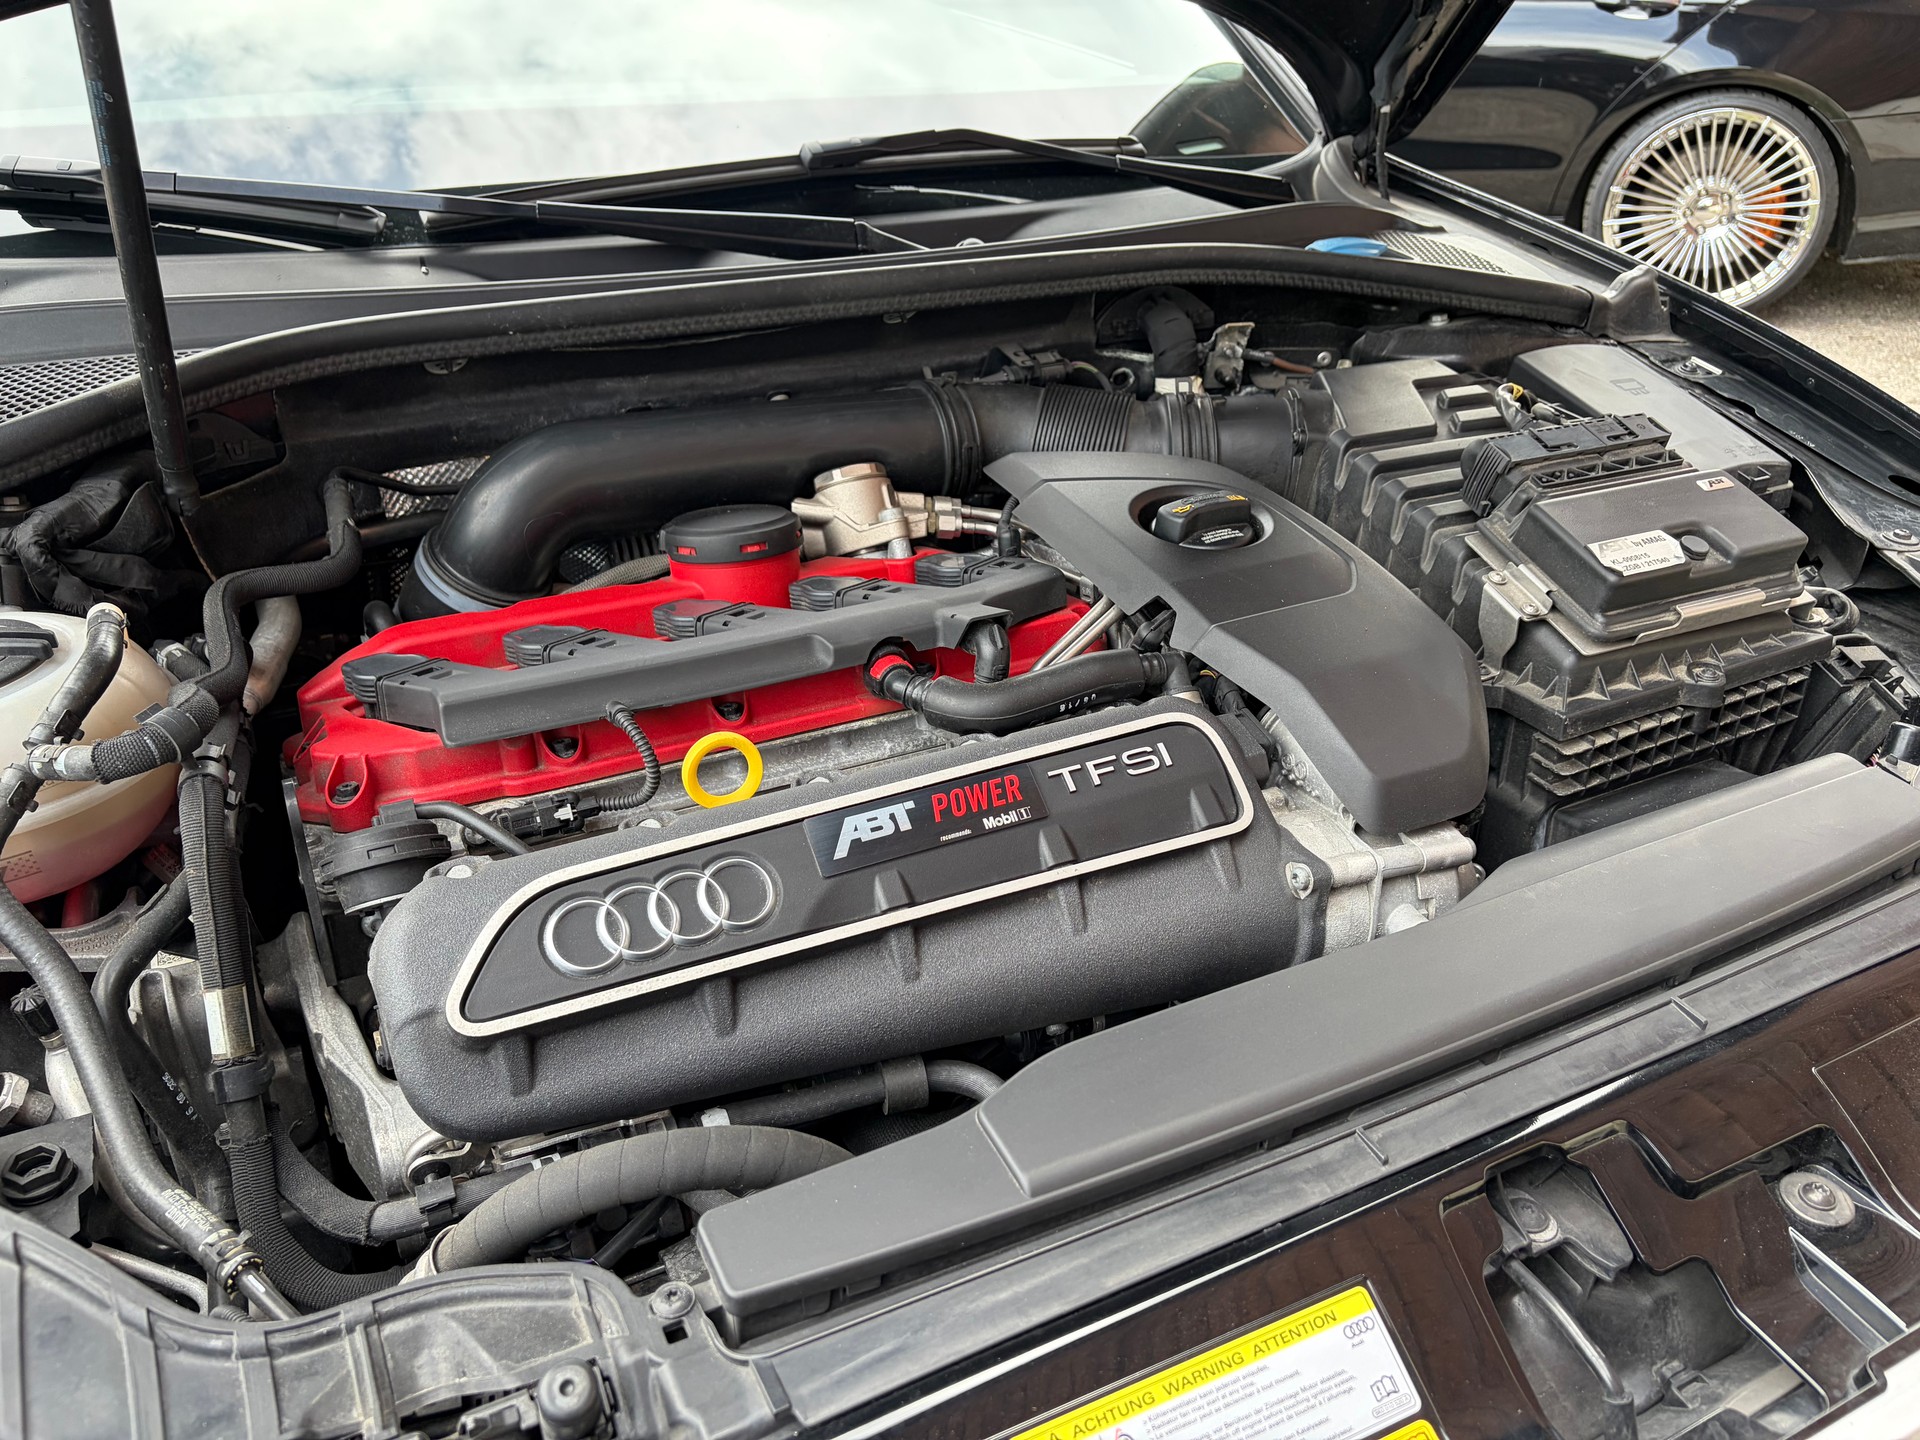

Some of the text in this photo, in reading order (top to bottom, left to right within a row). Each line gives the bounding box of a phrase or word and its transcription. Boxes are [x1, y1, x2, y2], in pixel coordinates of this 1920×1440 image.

[1631, 540, 1643, 548] by
[1643, 535, 1667, 546] AMAG
[1048, 742, 1174, 793] TFSI
[833, 773, 1023, 861] ABT POWER
[982, 811, 1018, 831] Mobil
[1351, 1339, 1365, 1349] Audi
[1073, 1310, 1337, 1438] ACHTUNG WARNING ATTENTION
